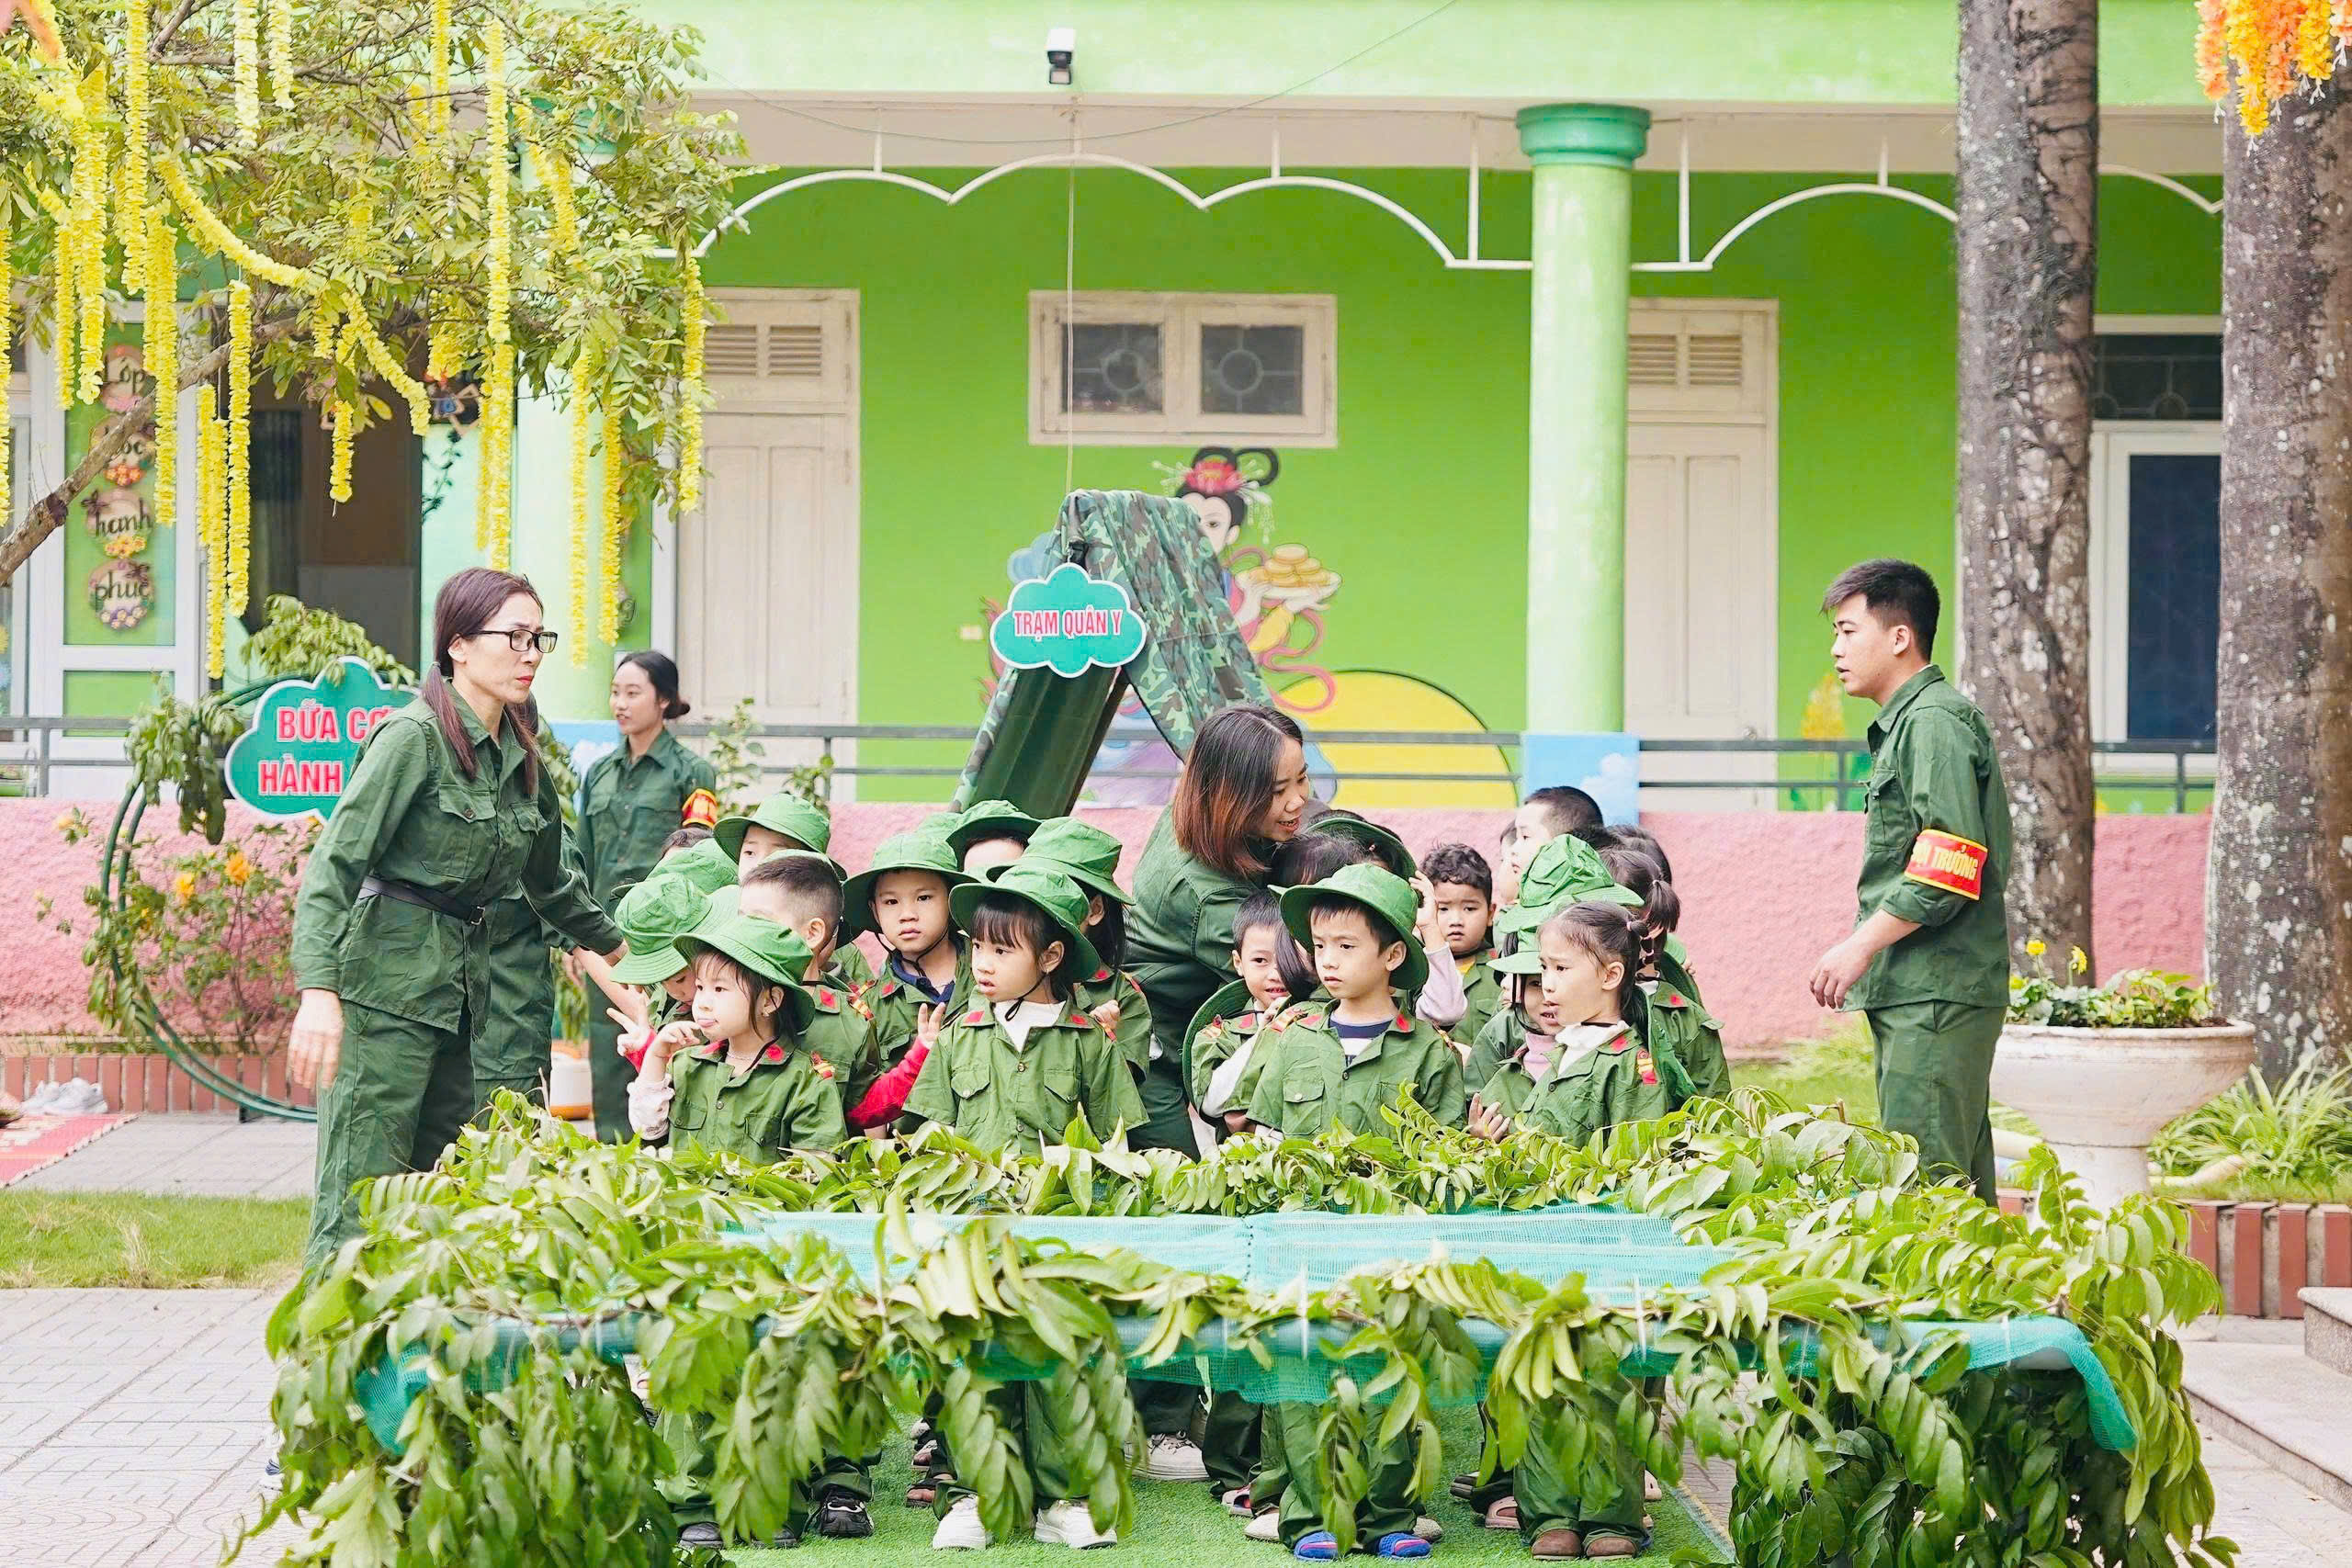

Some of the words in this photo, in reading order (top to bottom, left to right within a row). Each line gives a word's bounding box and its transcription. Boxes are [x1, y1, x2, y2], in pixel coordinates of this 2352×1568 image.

[1013, 610, 1059, 641] TRẠM
[1064, 604, 1108, 639] QUÂN
[1111, 610, 1123, 636] Y
[277, 698, 339, 742] BỮA
[259, 752, 343, 795] HÀNH
